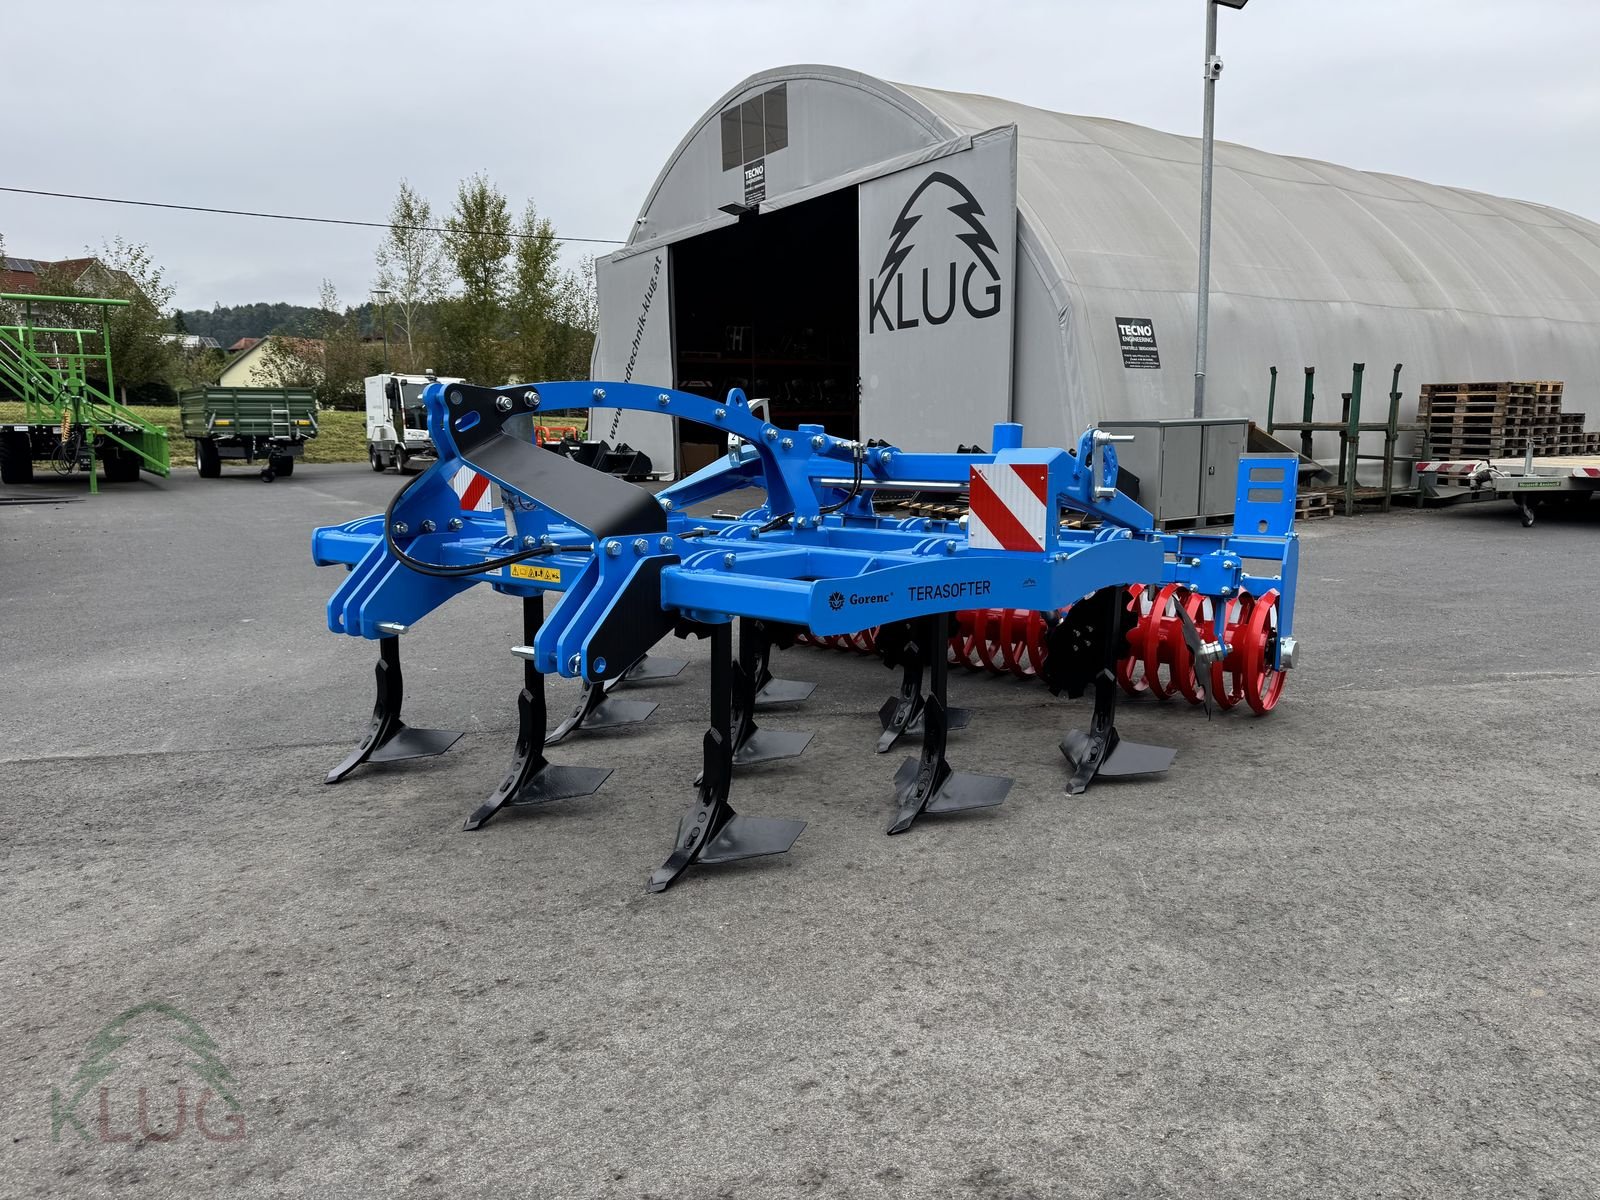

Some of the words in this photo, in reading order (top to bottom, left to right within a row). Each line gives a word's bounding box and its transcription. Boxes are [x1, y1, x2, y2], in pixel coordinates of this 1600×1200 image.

[745, 165, 764, 180] TECNO
[869, 261, 1001, 334] KLUG
[1118, 324, 1152, 336] TECNO
[850, 593, 889, 605] Gorenc
[908, 580, 991, 601] TERASOFTER
